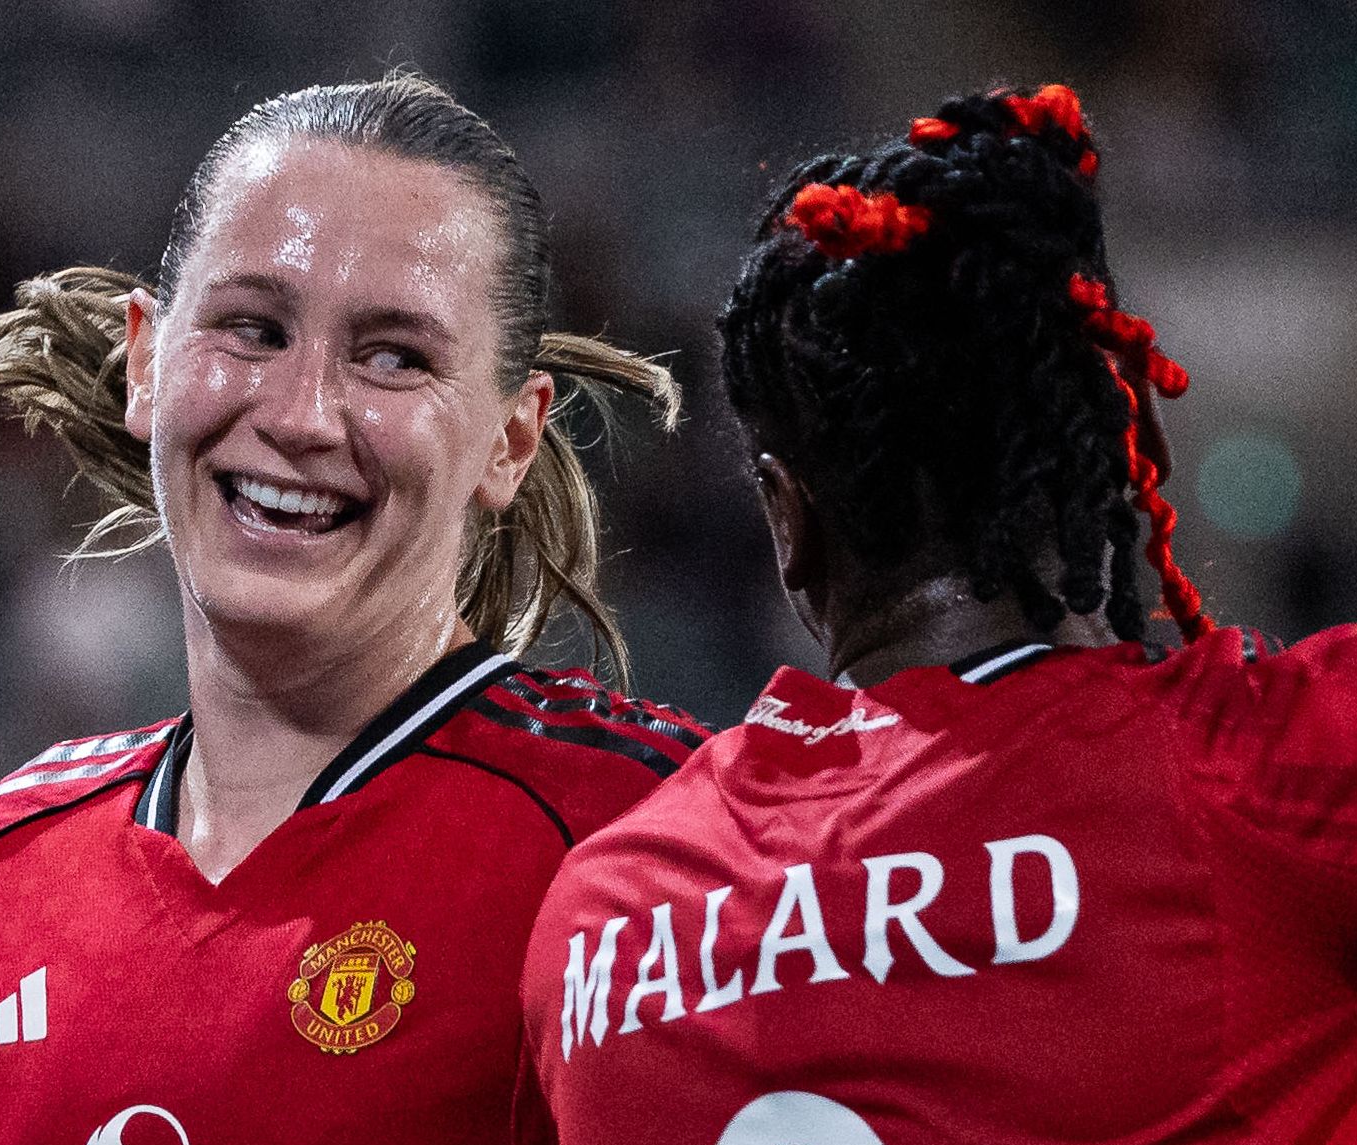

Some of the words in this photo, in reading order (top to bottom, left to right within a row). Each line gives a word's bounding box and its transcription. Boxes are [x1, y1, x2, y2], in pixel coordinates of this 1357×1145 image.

[310, 929, 406, 971] MANCHESTER
[561, 833, 1081, 1063] MALARD
[307, 1019, 379, 1044] UNITED
